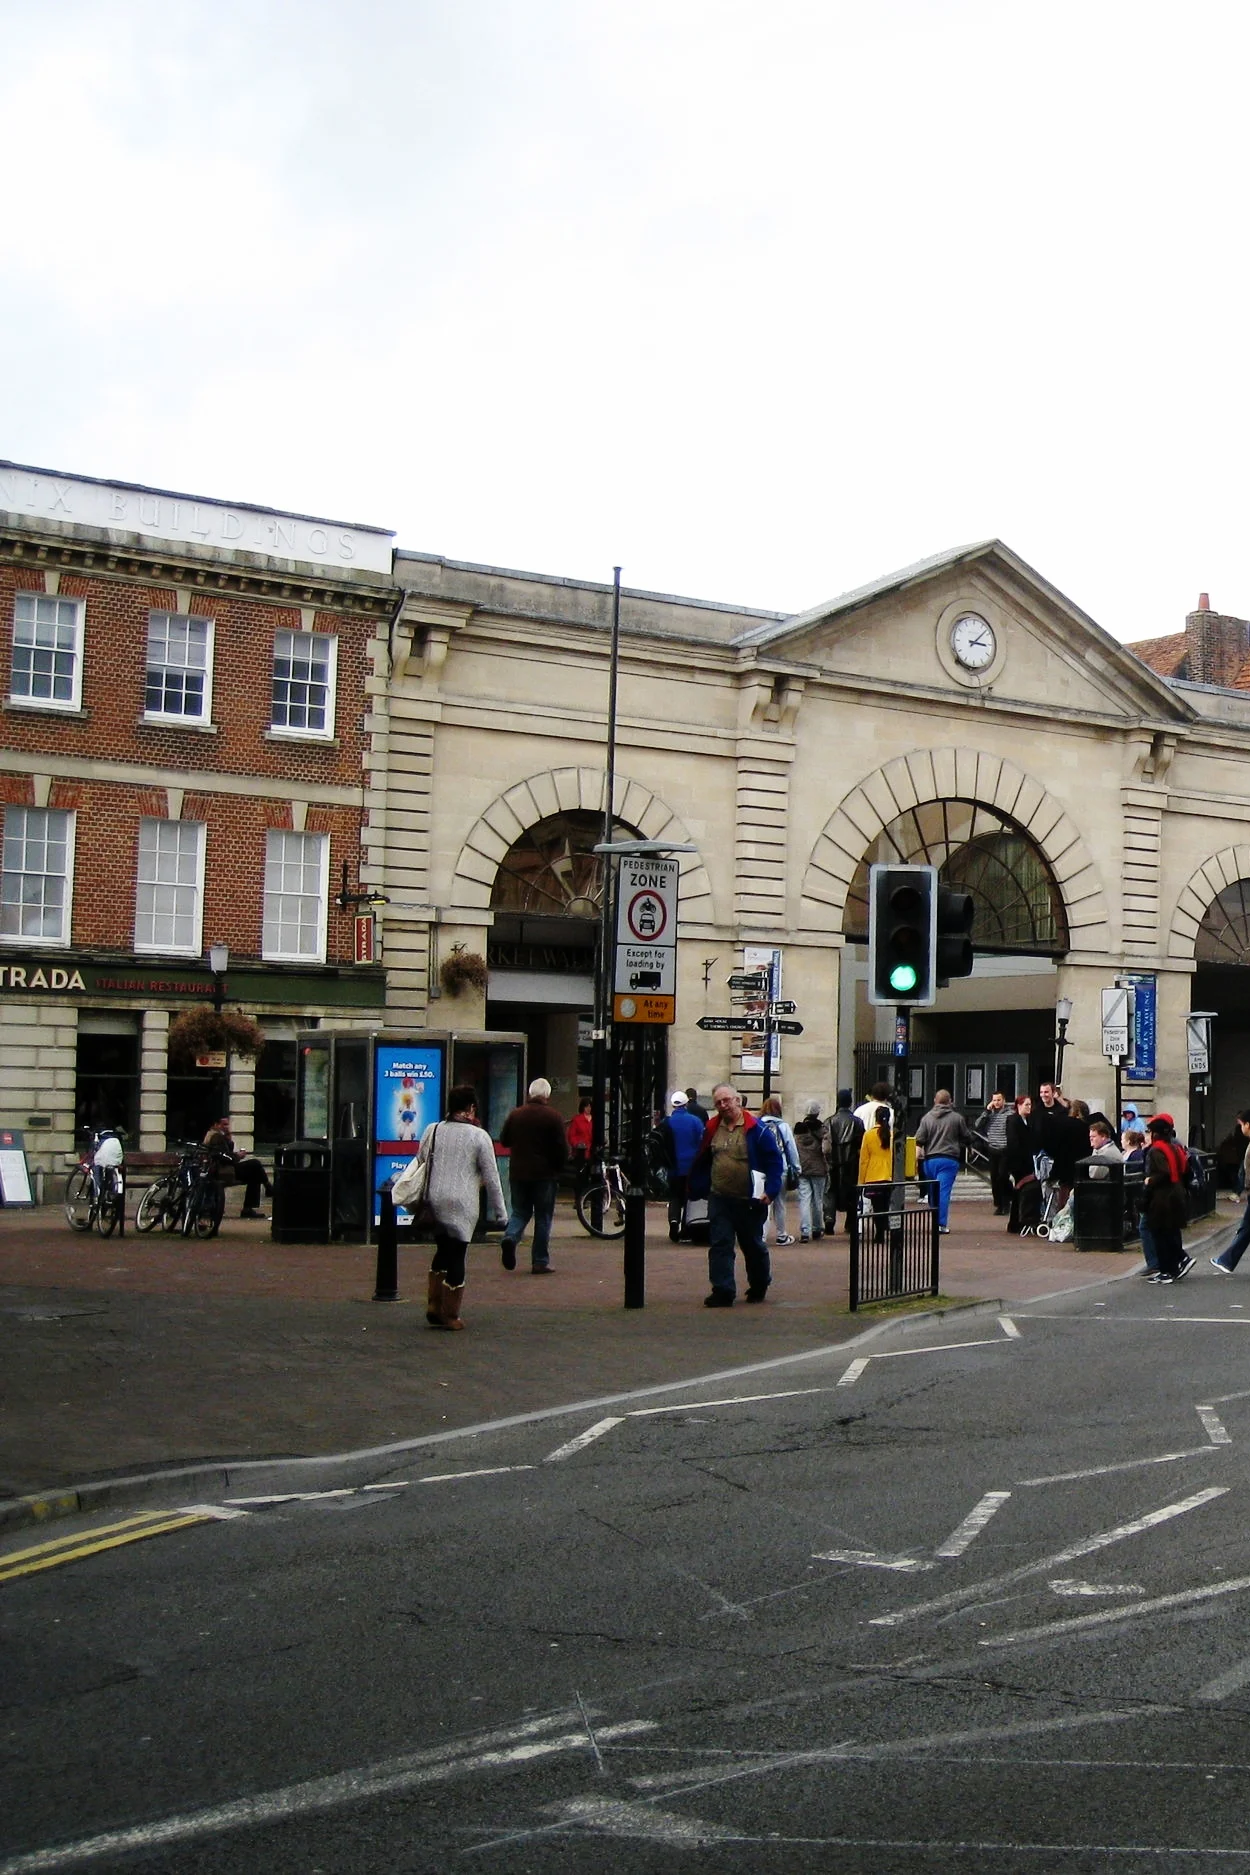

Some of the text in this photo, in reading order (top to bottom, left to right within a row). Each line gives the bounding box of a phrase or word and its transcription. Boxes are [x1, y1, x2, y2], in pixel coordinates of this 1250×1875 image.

[108, 493, 356, 560] BUILDINGS
[623, 860, 675, 872] PEDESTRIAN
[630, 873, 667, 889] ZONE
[626, 949, 665, 958] Except for
[626, 960, 665, 970] loading by
[95, 978, 145, 991] ITALIAN
[150, 980, 229, 994] RESTAURAT
[643, 1000, 668, 1009] At any
[647, 1010, 665, 1018] time
[1105, 1043, 1125, 1052] ENDS
[391, 1161, 408, 1170] Play
